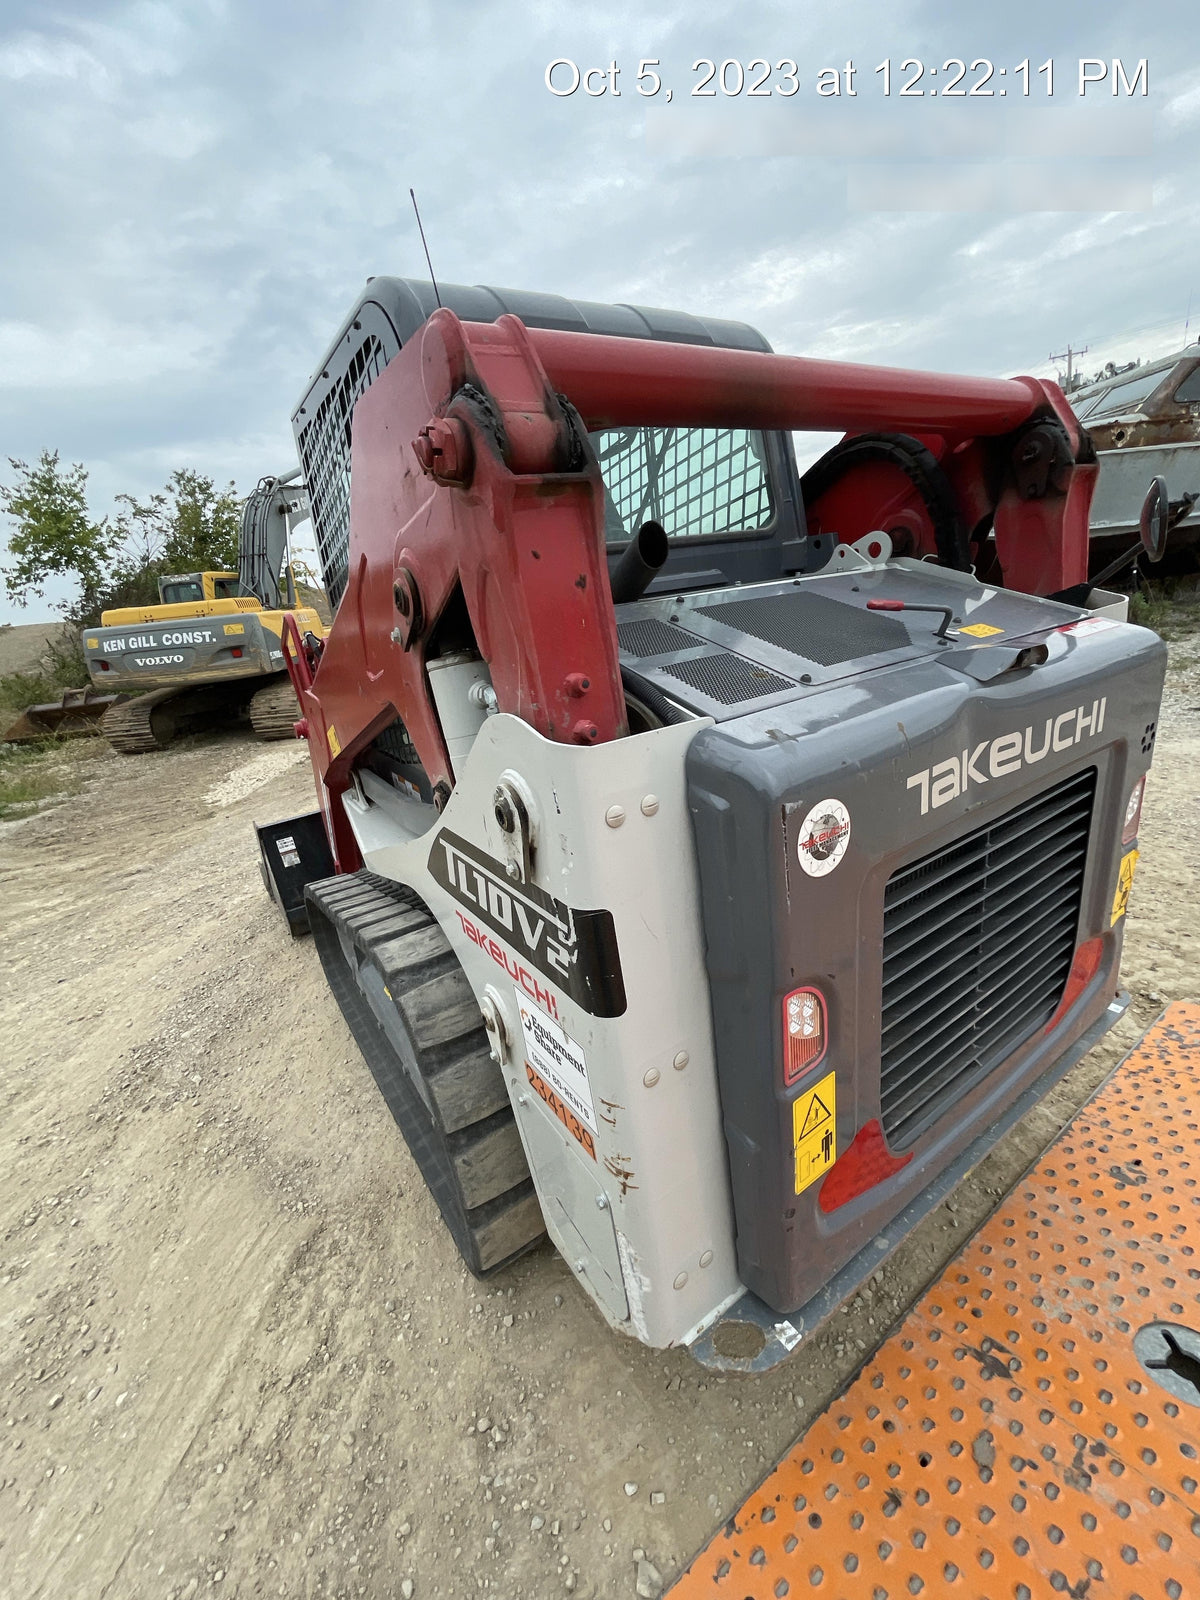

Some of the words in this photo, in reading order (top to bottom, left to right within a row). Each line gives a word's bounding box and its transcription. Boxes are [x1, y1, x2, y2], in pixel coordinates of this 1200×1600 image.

[103, 638, 126, 653] KEN
[128, 635, 157, 649] GILL
[162, 631, 217, 646] CONST.
[134, 655, 184, 667] VOLVO
[530, 1014, 586, 1078] Equipment
[533, 1029, 562, 1066] Share
[525, 1063, 598, 1163] 234139
